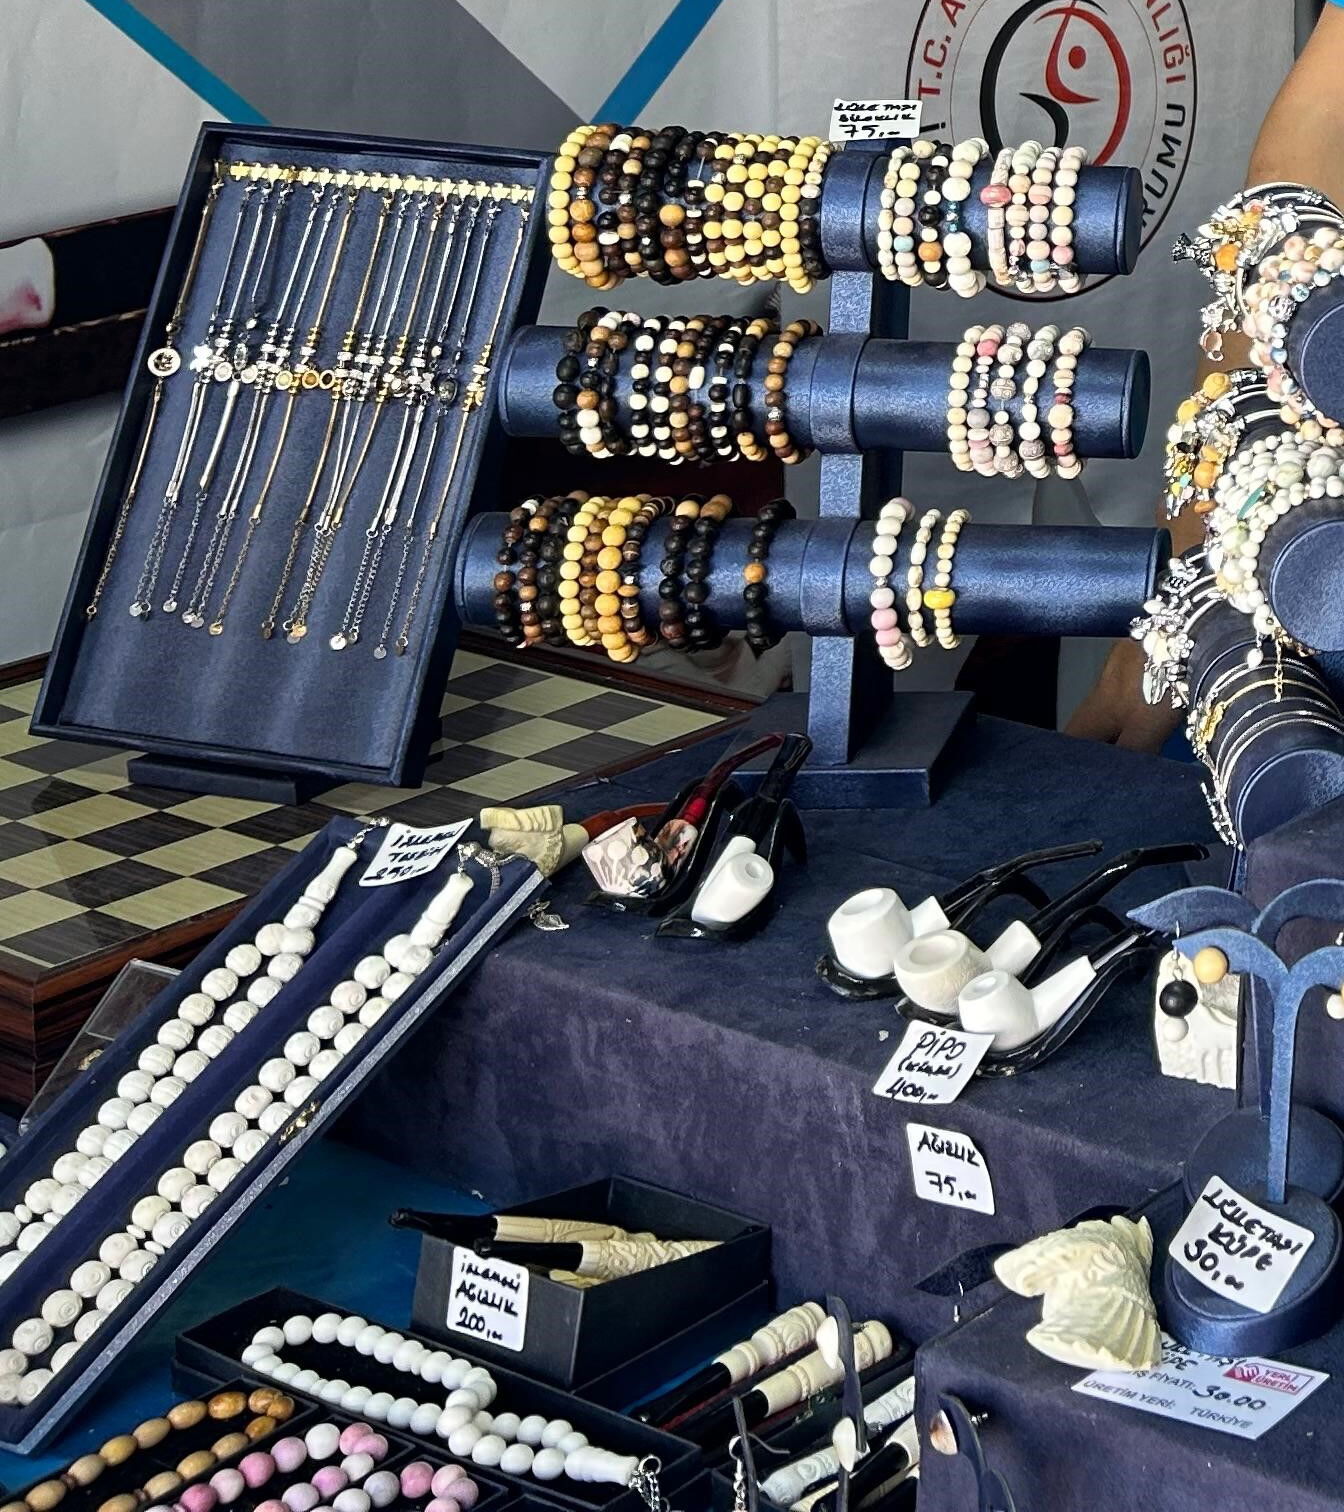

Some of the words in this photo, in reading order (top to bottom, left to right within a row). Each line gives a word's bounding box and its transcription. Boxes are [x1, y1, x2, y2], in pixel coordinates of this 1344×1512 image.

[909, 1030, 967, 1061] PİPO
[1083, 1379, 1138, 1399] ÜRETİM
[1190, 1405, 1254, 1430] TÜRKİYE
